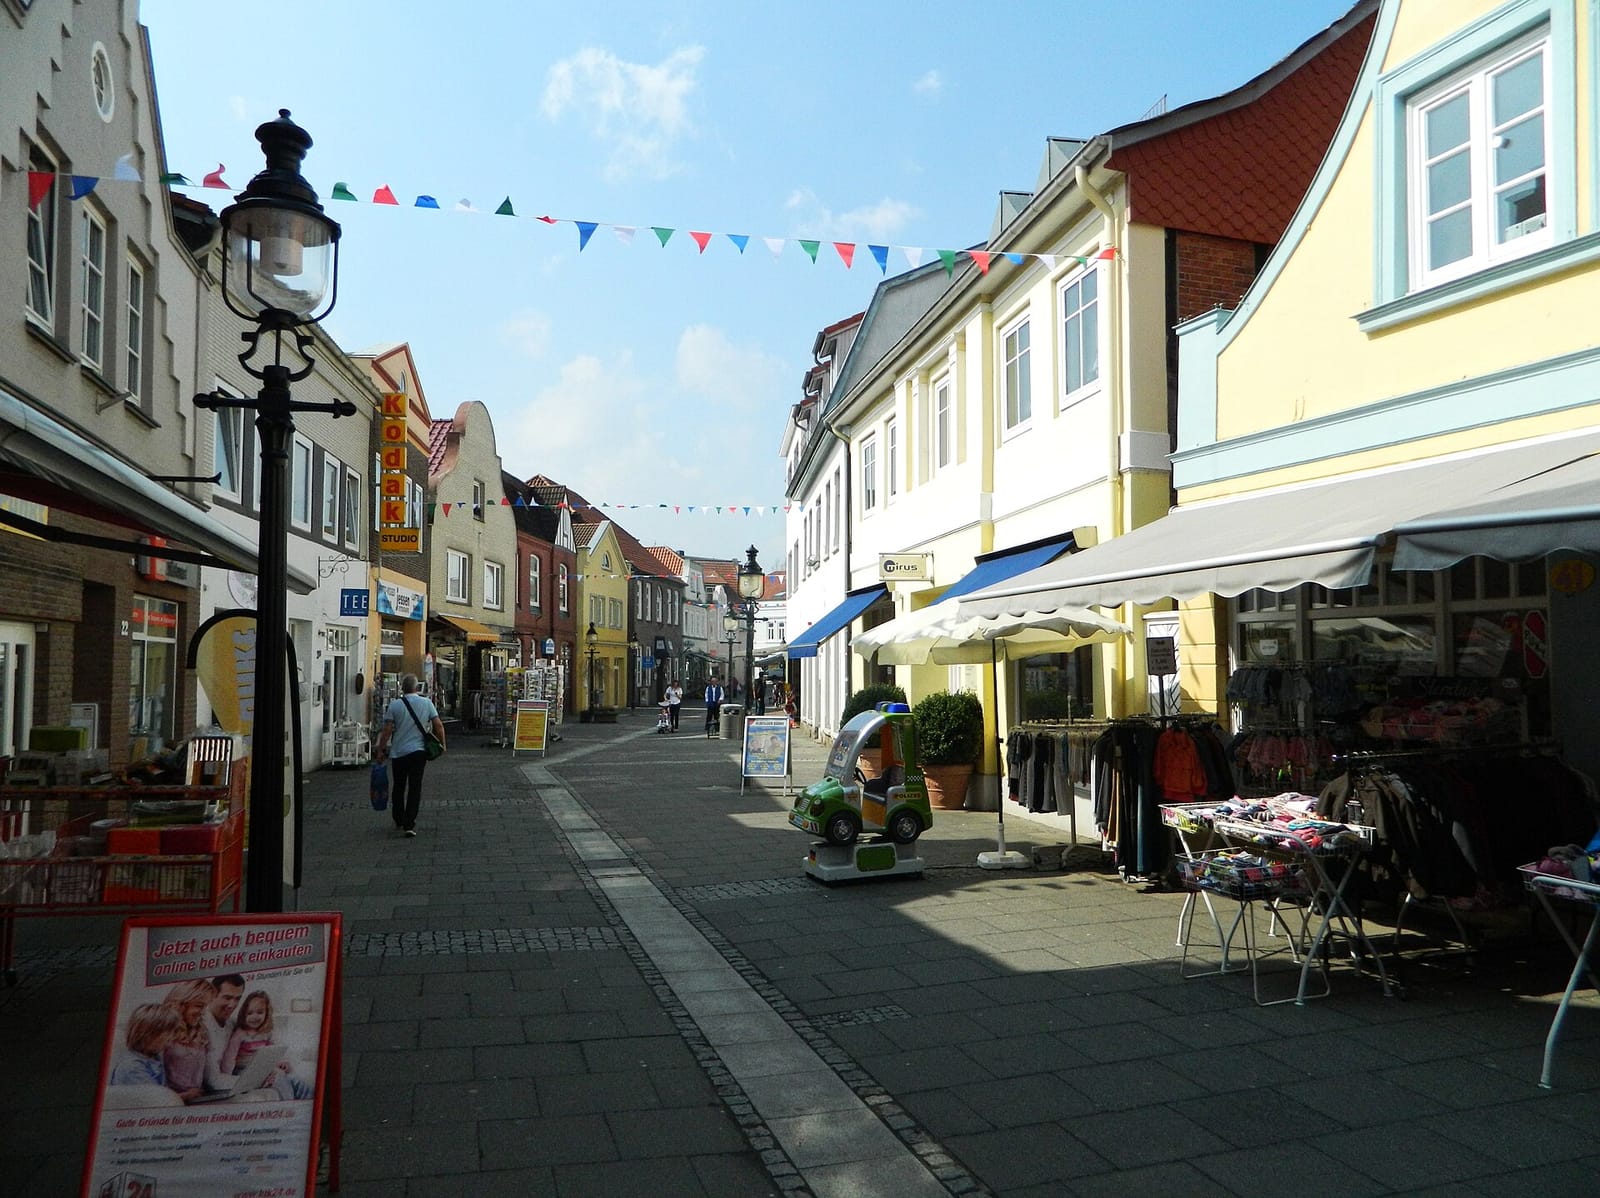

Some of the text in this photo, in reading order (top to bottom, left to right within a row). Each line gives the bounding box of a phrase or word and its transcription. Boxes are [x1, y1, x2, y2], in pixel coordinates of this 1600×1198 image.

[384, 395, 402, 521] Kodak
[381, 534, 418, 543] STUDIO
[343, 594, 368, 609] TEE
[121, 620, 129, 636] 22
[154, 926, 309, 958] Jetzt auch bequem
[154, 944, 312, 976] online bei KiK einkaufen
[116, 1119, 137, 1128] Gute
[138, 1117, 170, 1127] Gründe
[172, 1115, 183, 1125] für
[186, 1115, 208, 1123] Ihren
[210, 1112, 244, 1122] Einkauf
